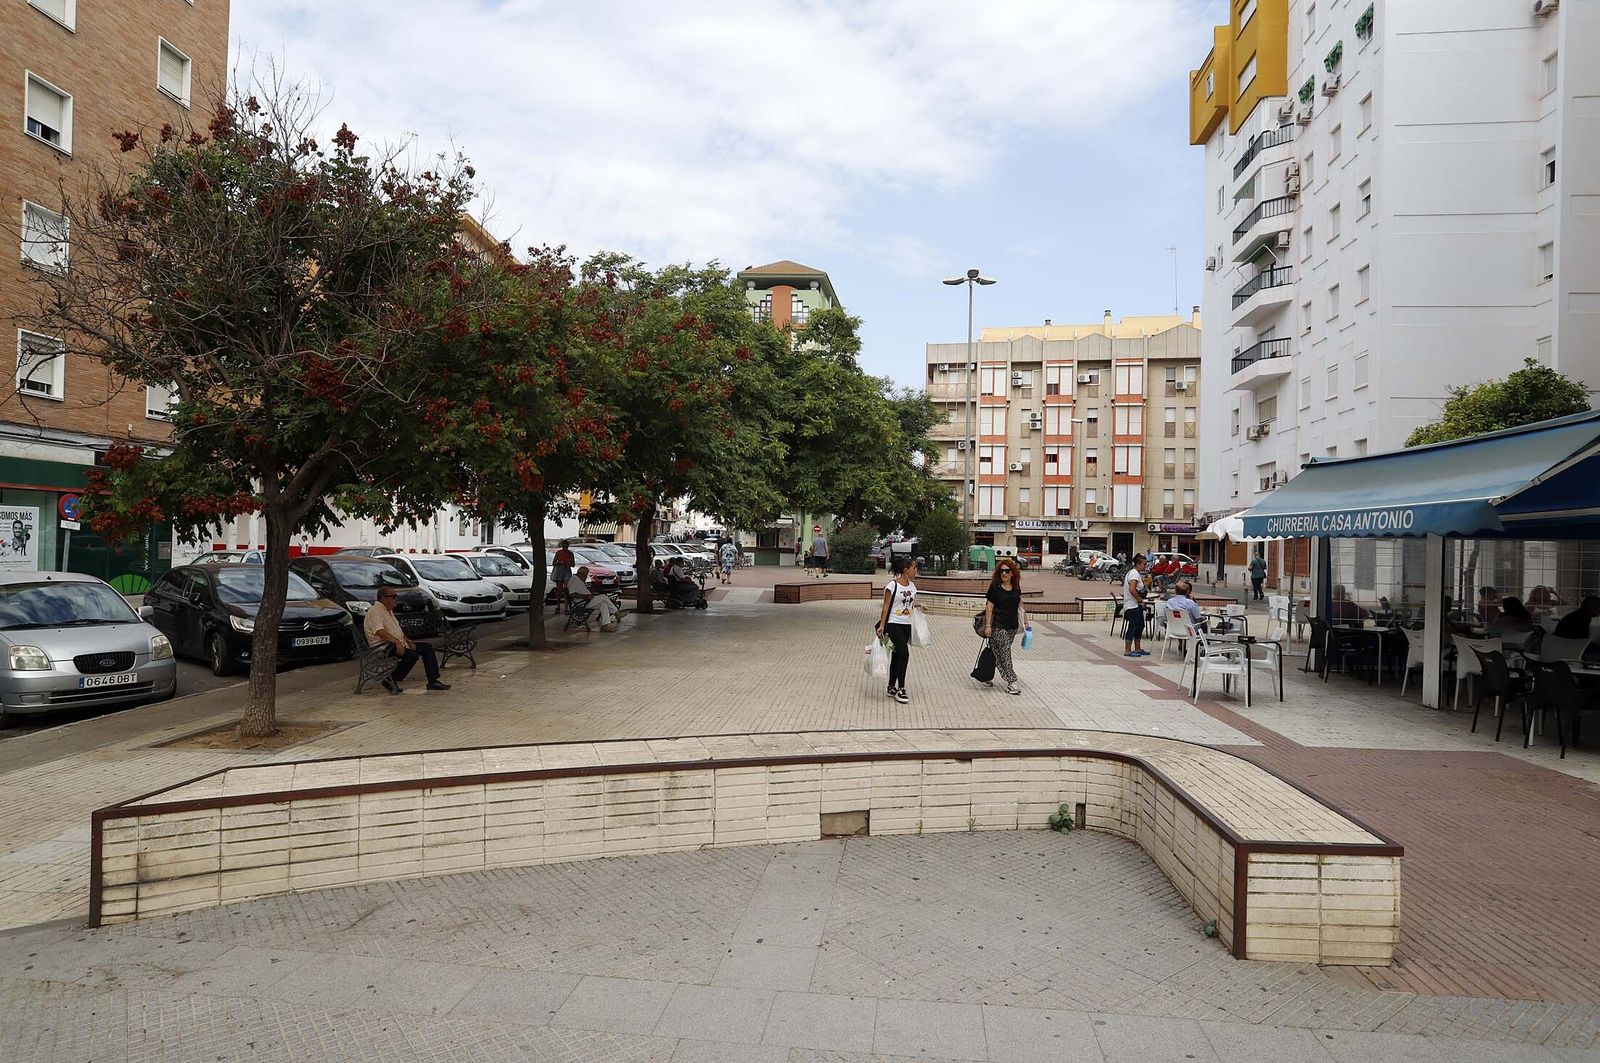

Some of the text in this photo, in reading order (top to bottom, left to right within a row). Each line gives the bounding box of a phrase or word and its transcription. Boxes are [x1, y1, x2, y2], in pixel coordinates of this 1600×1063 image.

[1267, 509, 1414, 533] CHURRERIA CASA ANTONIO
[86, 673, 136, 687] 0646 DBT
